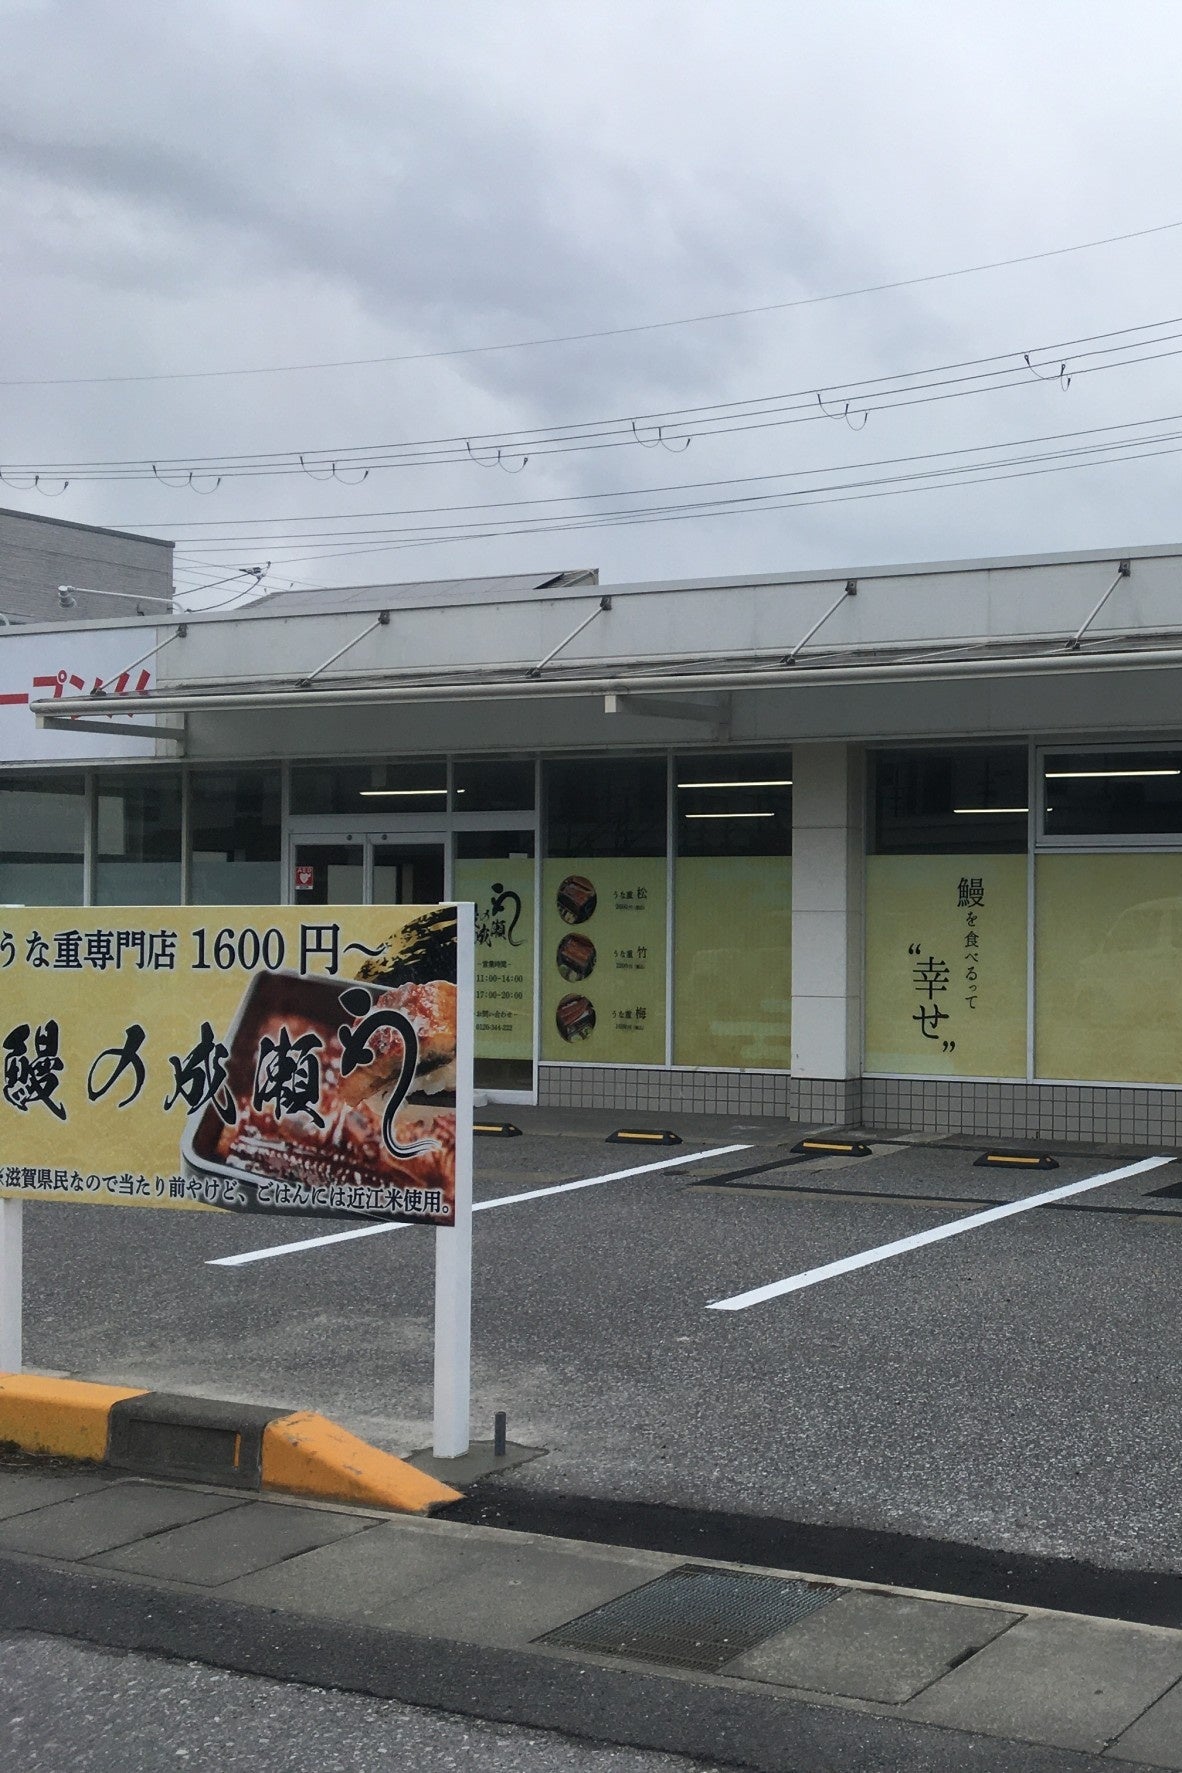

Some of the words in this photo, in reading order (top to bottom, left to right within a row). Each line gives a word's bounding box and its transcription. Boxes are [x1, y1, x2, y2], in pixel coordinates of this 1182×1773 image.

[0, 930, 178, 970] うな重専門店
[957, 877, 985, 1009] 鰻を食べるって
[2, 1019, 327, 1130] 鰻の成瀬
